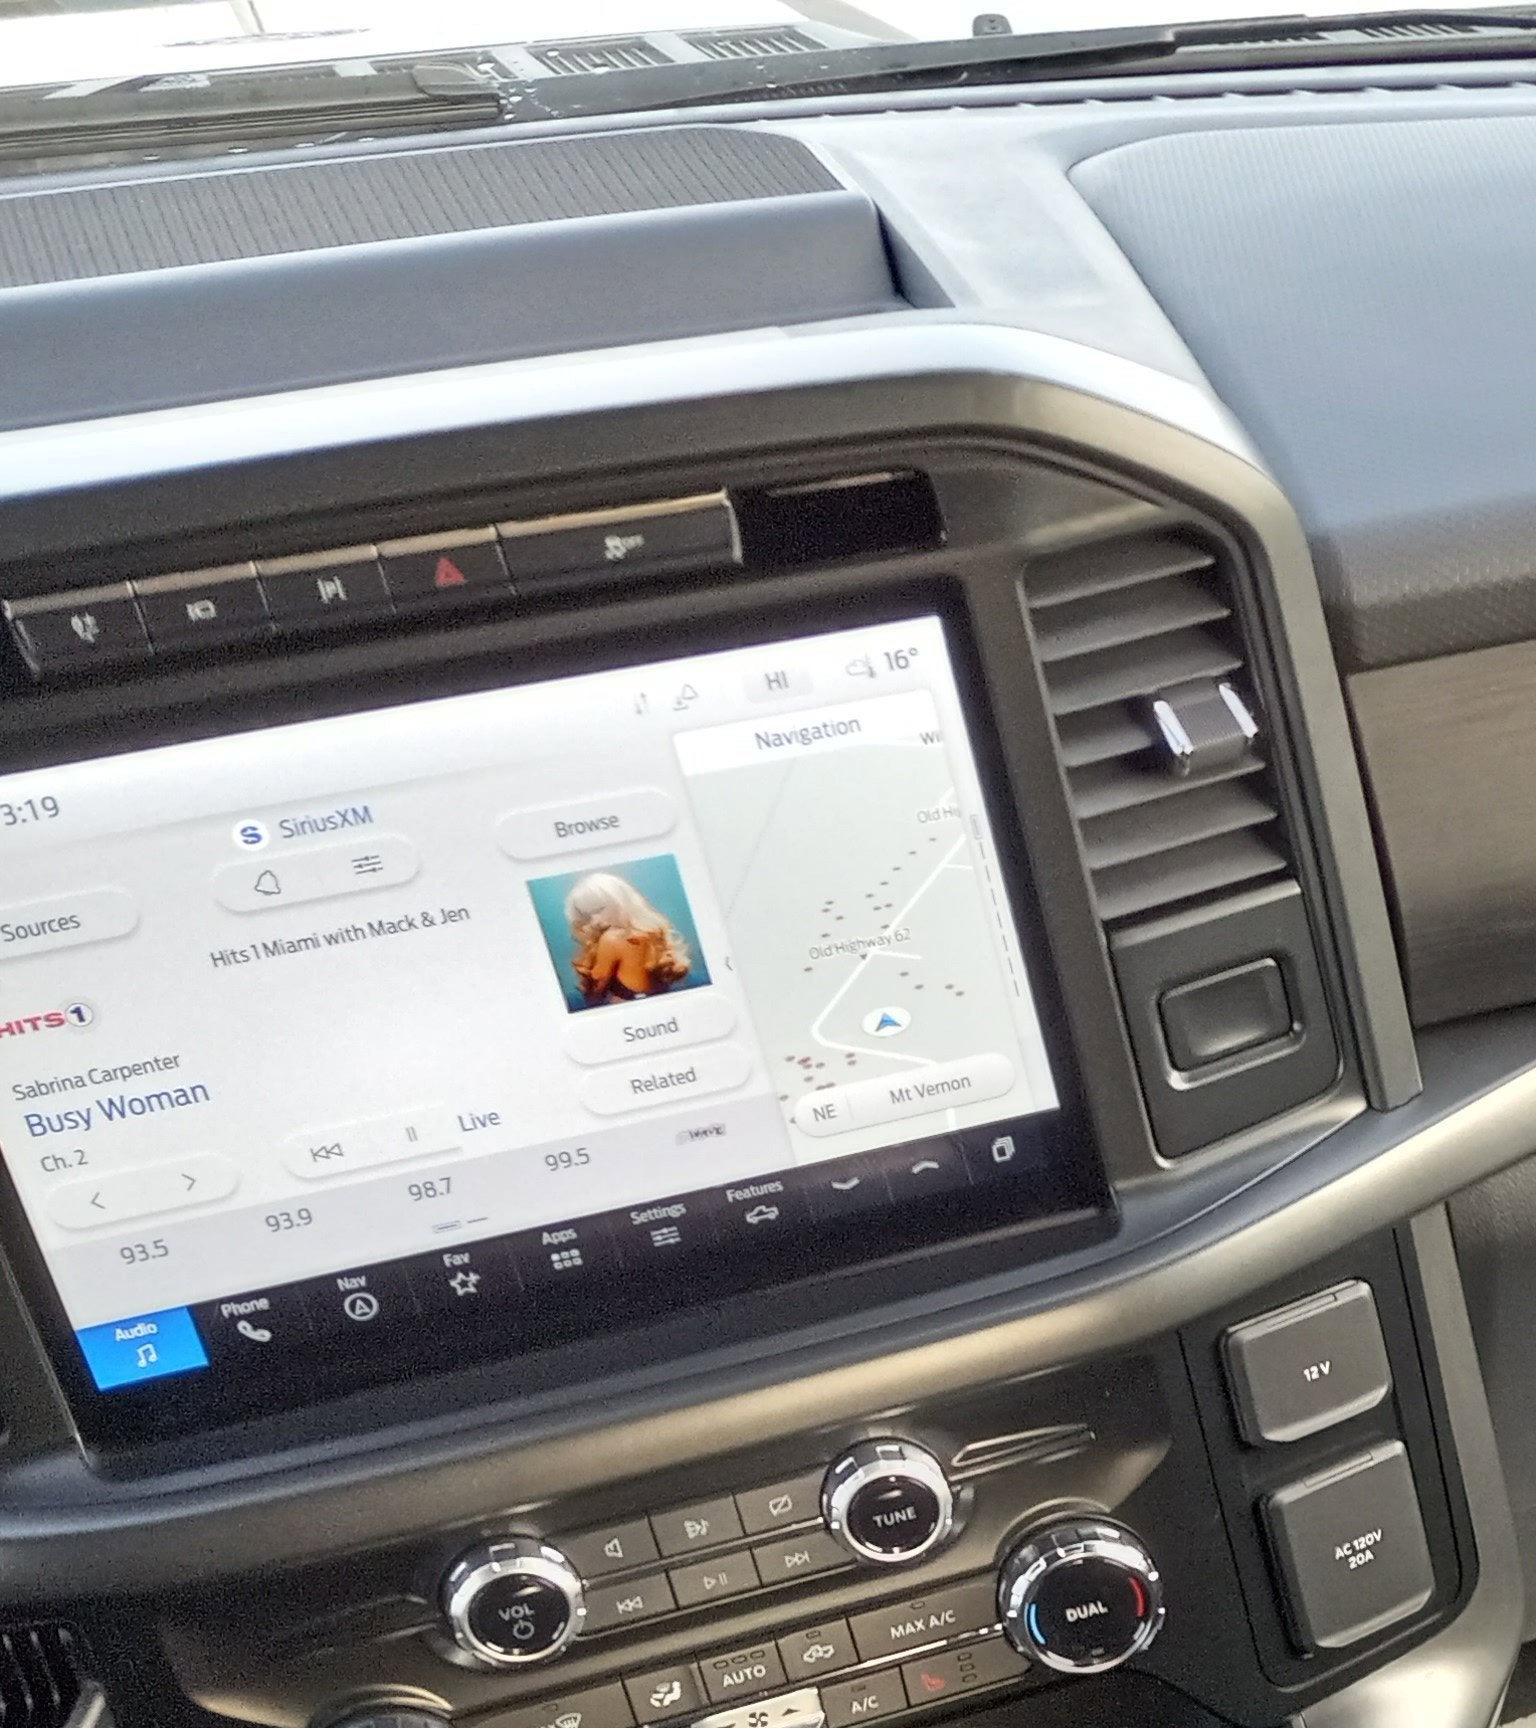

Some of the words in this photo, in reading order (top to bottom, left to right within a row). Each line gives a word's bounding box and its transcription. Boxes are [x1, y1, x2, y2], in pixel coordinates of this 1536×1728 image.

[883, 647, 919, 672] 16°
[765, 670, 789, 690] HI
[754, 715, 862, 751] Navigation
[278, 805, 374, 839] SiriusXM
[554, 813, 621, 839] Browse
[0, 911, 81, 943] Sources
[210, 950, 251, 968] Hits
[250, 944, 261, 960] 1
[263, 932, 321, 958] Miami
[323, 924, 366, 947] with
[367, 914, 415, 937] Mack
[420, 911, 436, 927] &
[440, 906, 471, 925] Jen
[808, 944, 834, 960] Old
[834, 933, 892, 954] Highway
[894, 927, 912, 943] 62
[69, 1005, 87, 1024] 1
[623, 1016, 680, 1043] Sound
[12, 1073, 87, 1102] Sabrina
[87, 1054, 181, 1085] Carpenter
[630, 1066, 697, 1096] Related
[889, 1083, 915, 1105] Mt
[915, 1073, 972, 1100] Vernon
[24, 1105, 92, 1138] Busy
[95, 1083, 210, 1123] Woman
[457, 1109, 501, 1133] Live
[812, 1104, 837, 1123] NE
[40, 1153, 72, 1174] Ch.
[73, 1148, 88, 1167] 2
[544, 1147, 591, 1172] 99.5
[408, 1176, 454, 1202] 98.7
[726, 1179, 784, 1203] Features
[265, 1206, 314, 1233] 93.9
[630, 1202, 687, 1226] Settings
[541, 1226, 578, 1247] Apps
[119, 1237, 170, 1266] 93.5
[442, 1249, 471, 1268] Fav
[336, 1274, 366, 1291] Nav
[220, 1296, 270, 1320] Phone
[114, 1320, 158, 1342] Audio
[872, 1506, 918, 1527] TUNE
[1335, 1541, 1355, 1562] AC
[1353, 1528, 1384, 1553] 120V
[1348, 1549, 1376, 1570] 20A
[498, 1603, 535, 1622] VOL
[1065, 1600, 1109, 1622] DUAL
[889, 1617, 926, 1640] MAX
[928, 1609, 957, 1631] A/C
[721, 1663, 767, 1688] AUTO
[850, 1695, 879, 1714] A/C
